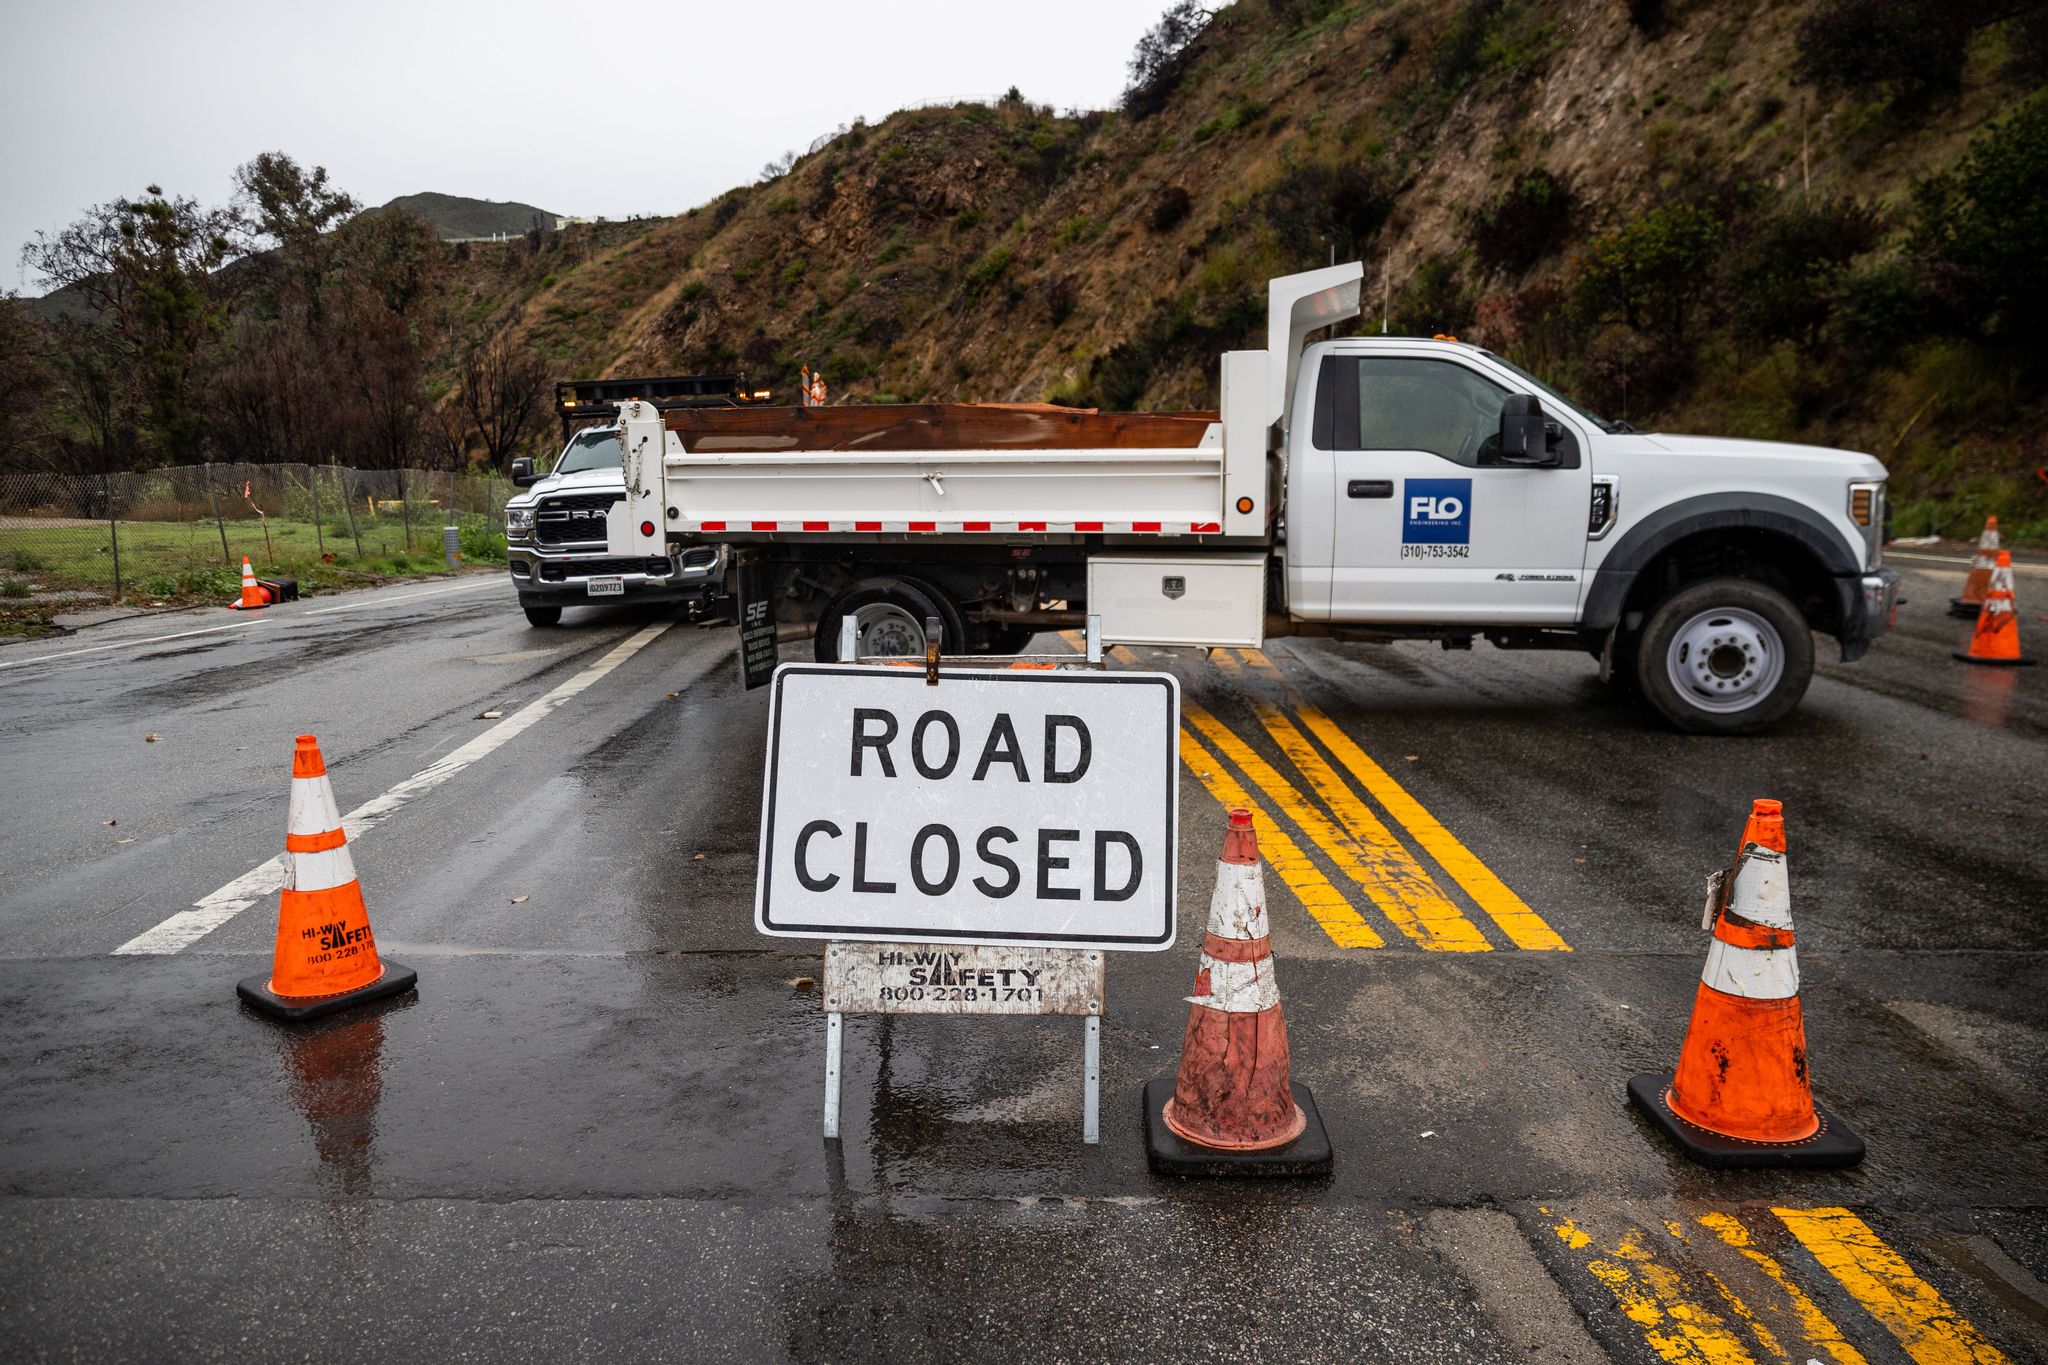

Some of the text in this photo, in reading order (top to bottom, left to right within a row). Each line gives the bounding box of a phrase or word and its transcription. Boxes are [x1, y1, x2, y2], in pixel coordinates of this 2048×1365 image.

[572, 510, 608, 519] RA
[1410, 497, 1463, 520] FLO
[1400, 545, 1470, 561] (310)-753-3542
[746, 600, 769, 622] SE
[849, 707, 1093, 784] ROAD
[793, 819, 1144, 902] CLOSED
[878, 952, 963, 966] HI-WAY
[908, 966, 1043, 986] SAFETY
